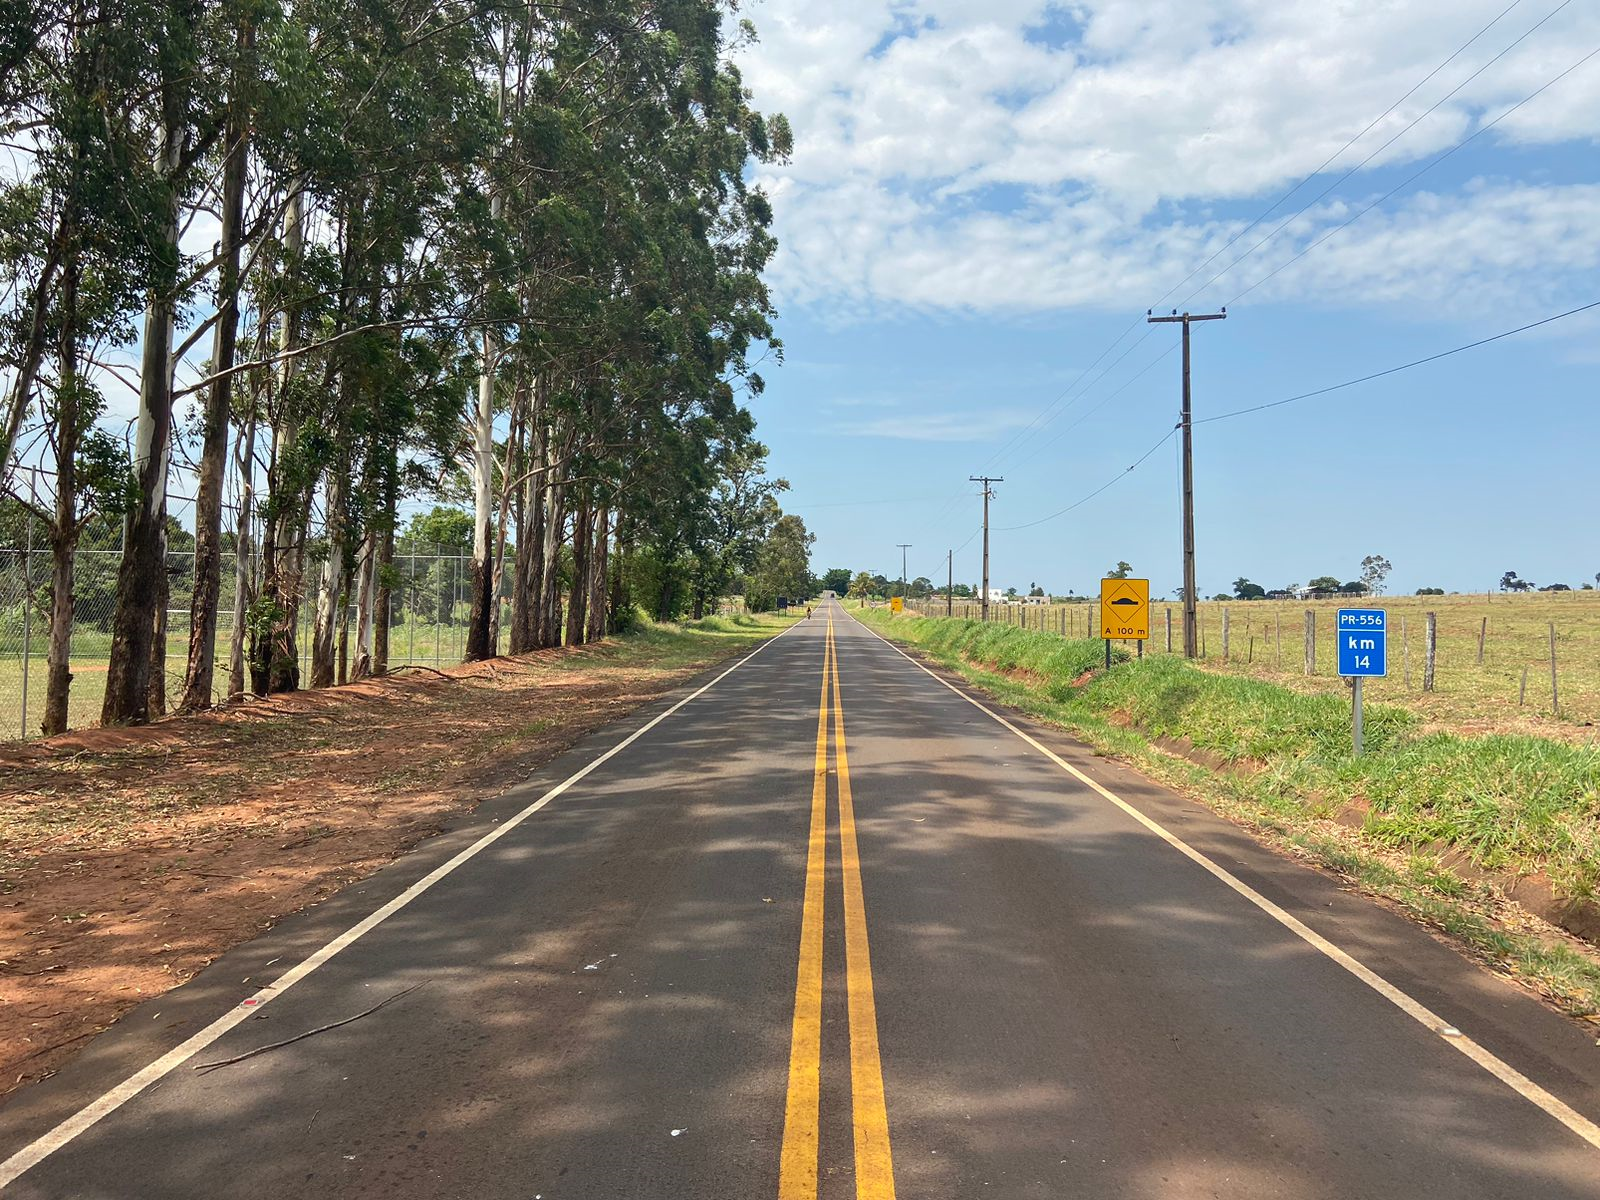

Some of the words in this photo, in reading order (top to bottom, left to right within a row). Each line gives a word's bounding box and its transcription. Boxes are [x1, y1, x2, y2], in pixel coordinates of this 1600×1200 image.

[1341, 615, 1382, 625] PR-556
[1105, 627, 1112, 635] A
[1117, 627, 1134, 635] 100
[1348, 635, 1375, 650] km
[1354, 655, 1370, 669] 14
